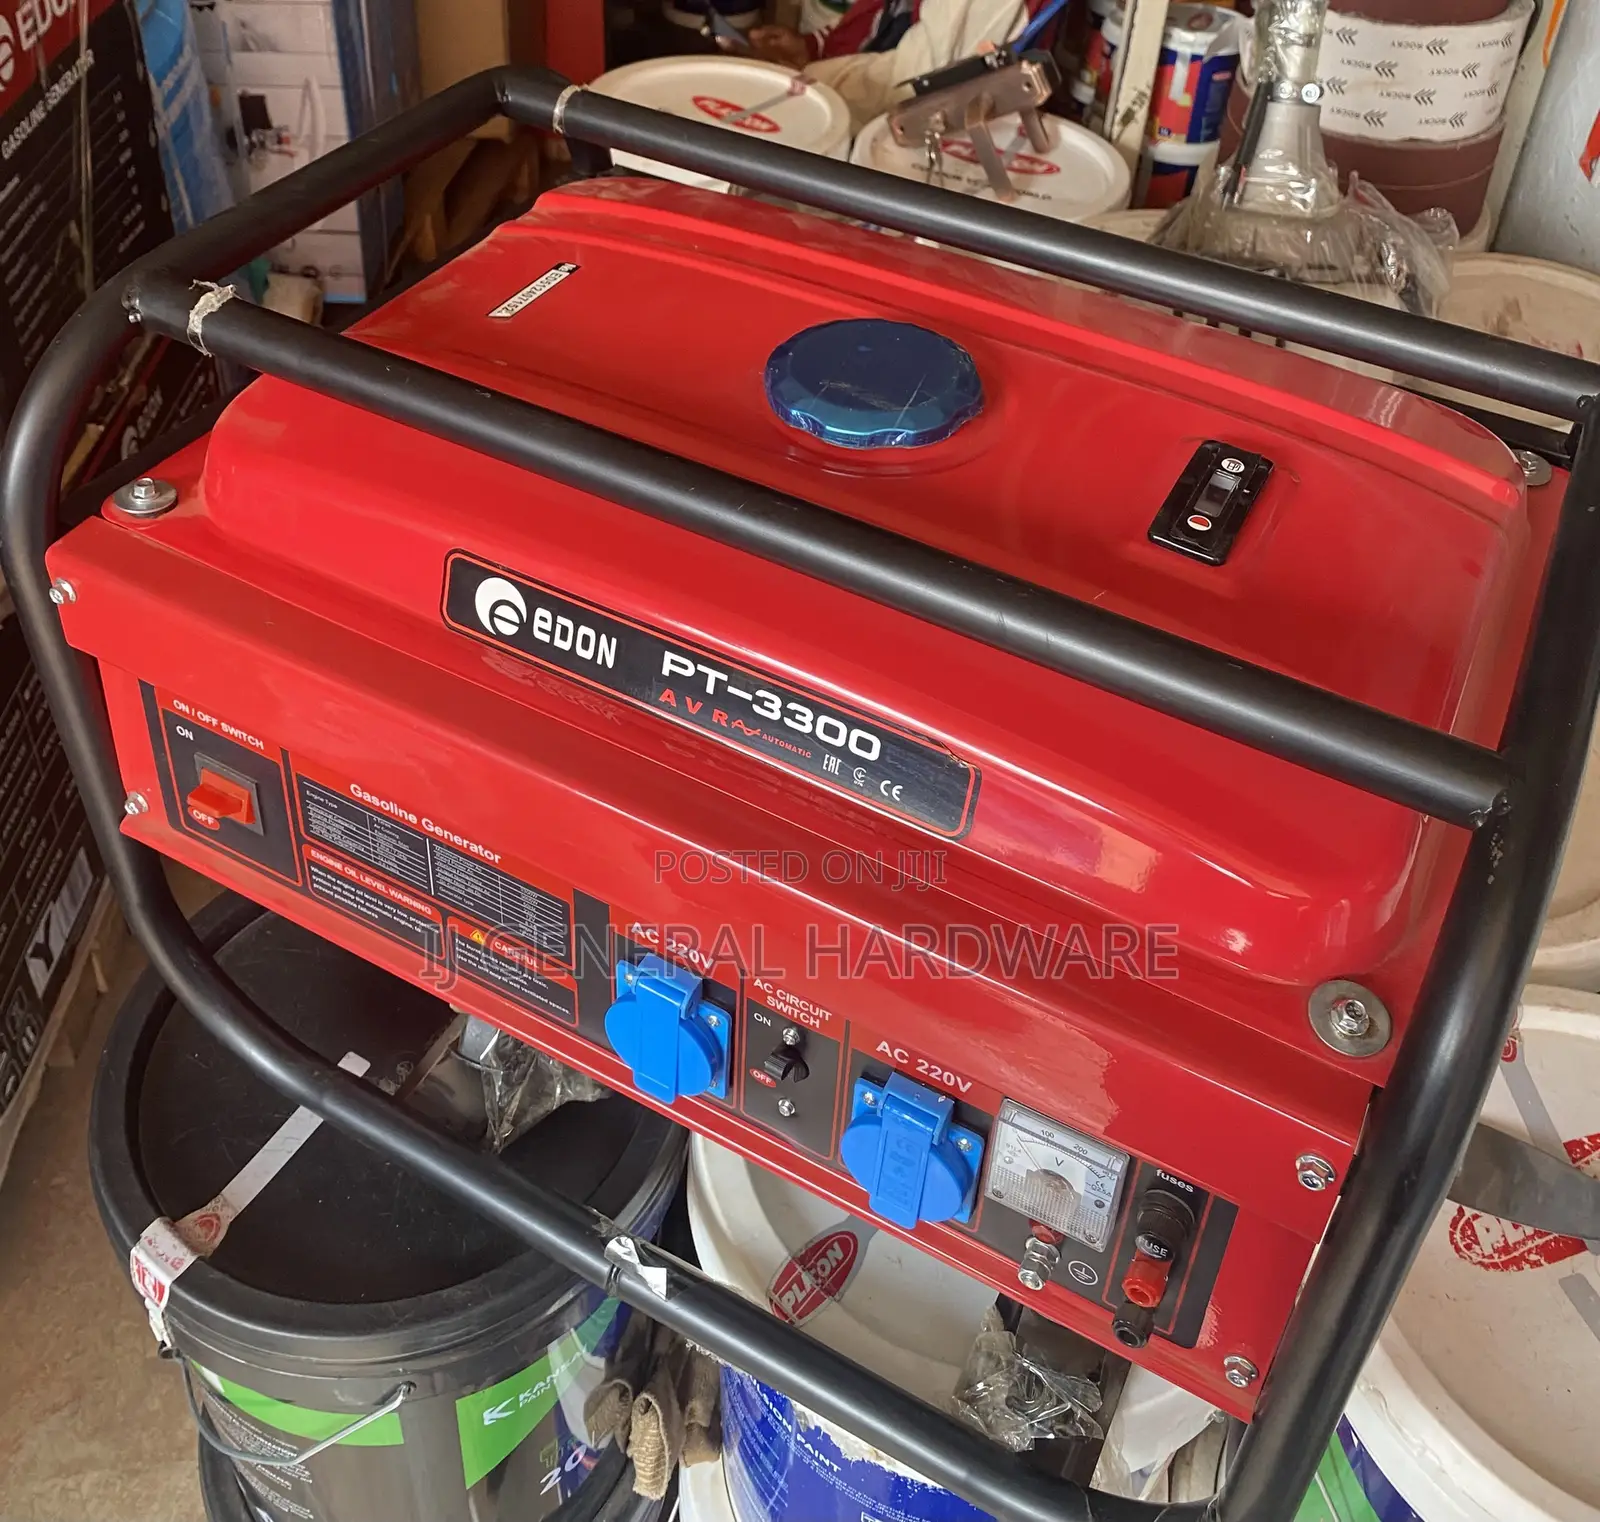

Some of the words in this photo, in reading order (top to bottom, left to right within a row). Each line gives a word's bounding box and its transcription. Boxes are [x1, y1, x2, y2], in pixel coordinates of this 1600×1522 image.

[16, 0, 77, 50] EDO
[1391, 40, 1424, 50] ROCKY
[1340, 57, 1372, 69] ROCKY
[1429, 68, 1459, 76] ROCKY
[2, 99, 48, 160] GASOLINE
[44, 49, 96, 111] GENERATOR
[1378, 91, 1411, 101] ROCKY
[1330, 107, 1362, 119] ROCKY
[661, 650, 882, 761] PT-3300
[173, 699, 190, 714] ON
[196, 711, 218, 728] OFF
[220, 722, 265, 750] SWITCH
[176, 725, 194, 741] ON
[761, 732, 812, 759] AUTOMATIC
[306, 790, 324, 802] Engine
[192, 809, 215, 826] OFF
[350, 783, 418, 825] Gasoline
[421, 817, 501, 864] Generator
[311, 850, 342, 870] ENGINE
[344, 866, 358, 878] OIL
[360, 874, 388, 892] LEVEL
[389, 889, 431, 914] WARNING
[311, 866, 325, 876] When
[337, 879, 354, 891] engine
[364, 893, 377, 902] level
[384, 904, 395, 912] very
[313, 882, 332, 895] prevent
[494, 941, 538, 967] CAREFUL
[631, 922, 660, 944] AC
[666, 937, 714, 970] 220V
[522, 987, 547, 1002] ventilated
[753, 978, 773, 994] AC
[776, 988, 832, 1022] CIRCUIT
[753, 1012, 771, 1027] ON
[766, 995, 820, 1028] SWITCH
[752, 1069, 773, 1084] OFF
[876, 1040, 909, 1064] AC
[916, 1058, 973, 1094] 220V
[1041, 1129, 1055, 1139] 100
[1073, 1143, 1088, 1155] 200
[1055, 1156, 1064, 1167] V
[1156, 1168, 1194, 1193] fuses
[1142, 1237, 1168, 1257] USE
[796, 1432, 842, 1473] PAINT
